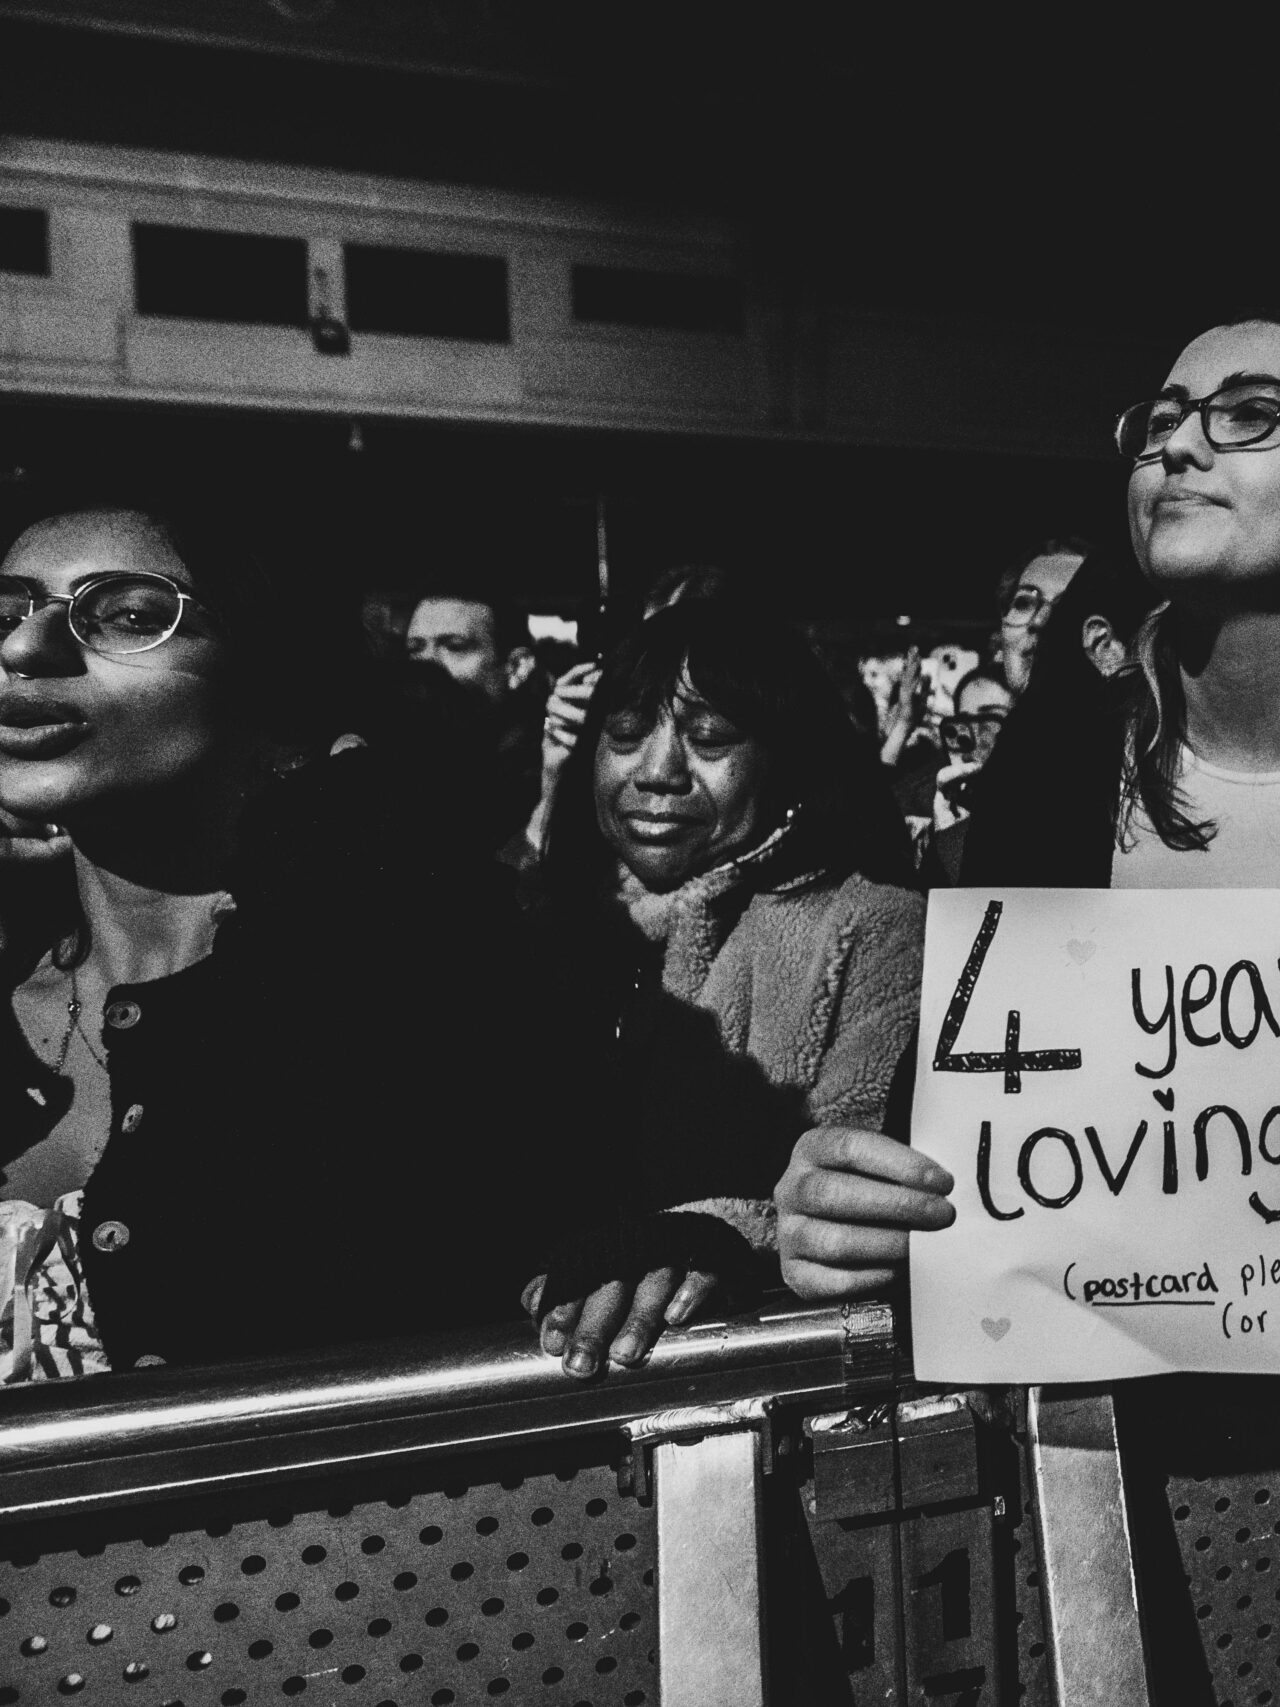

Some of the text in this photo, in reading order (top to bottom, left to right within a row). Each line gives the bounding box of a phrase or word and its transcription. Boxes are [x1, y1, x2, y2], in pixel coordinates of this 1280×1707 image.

[933, 900, 1082, 1094] 4
[1063, 1262, 1219, 1302] (postcard
[1222, 1301, 1268, 1339] (or
